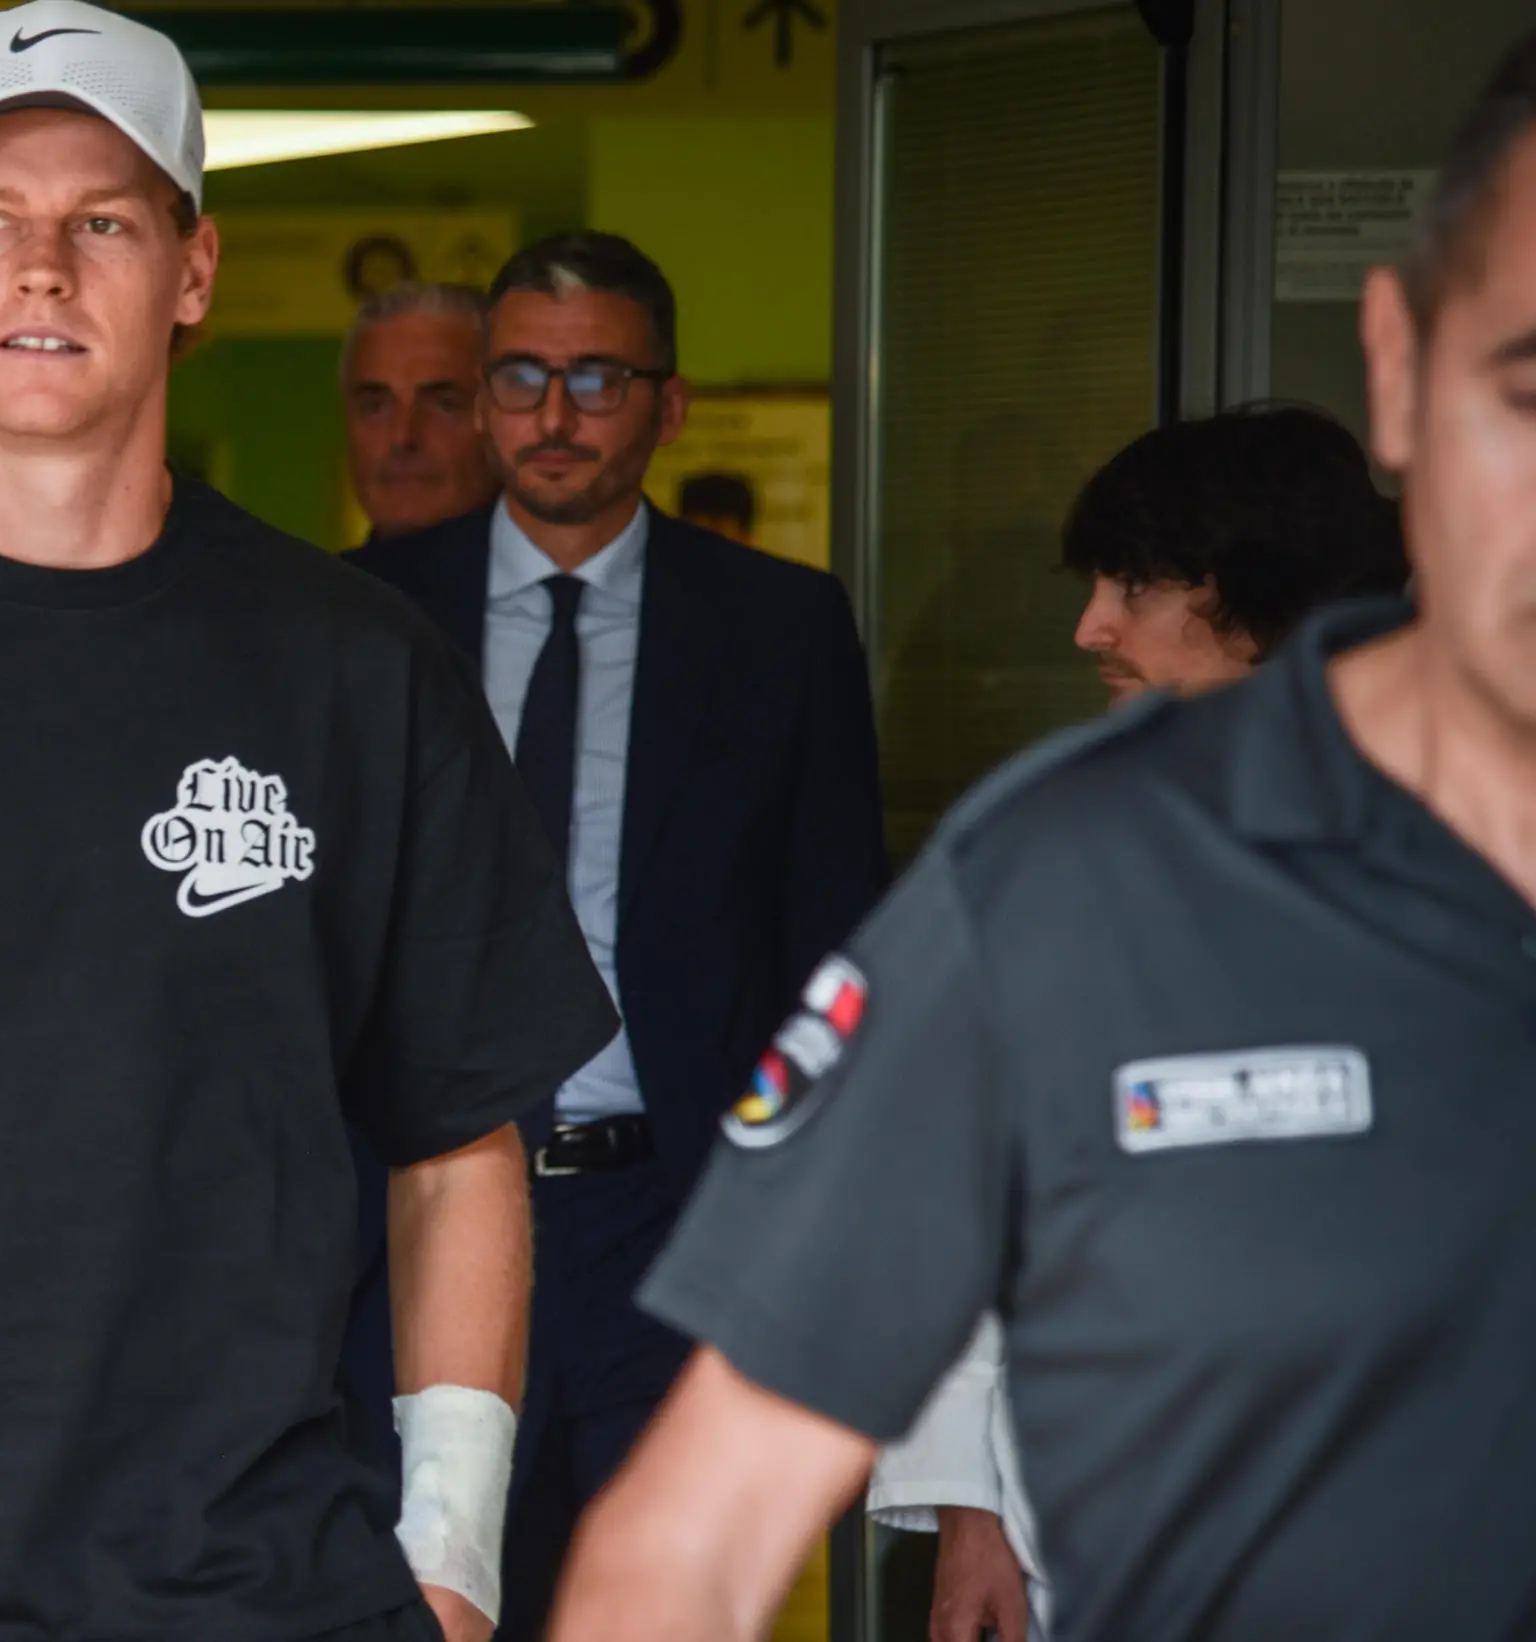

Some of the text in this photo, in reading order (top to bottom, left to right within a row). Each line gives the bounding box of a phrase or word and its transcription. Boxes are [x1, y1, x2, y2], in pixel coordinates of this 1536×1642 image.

[186, 766, 284, 815] Live
[150, 815, 310, 871] On Air
